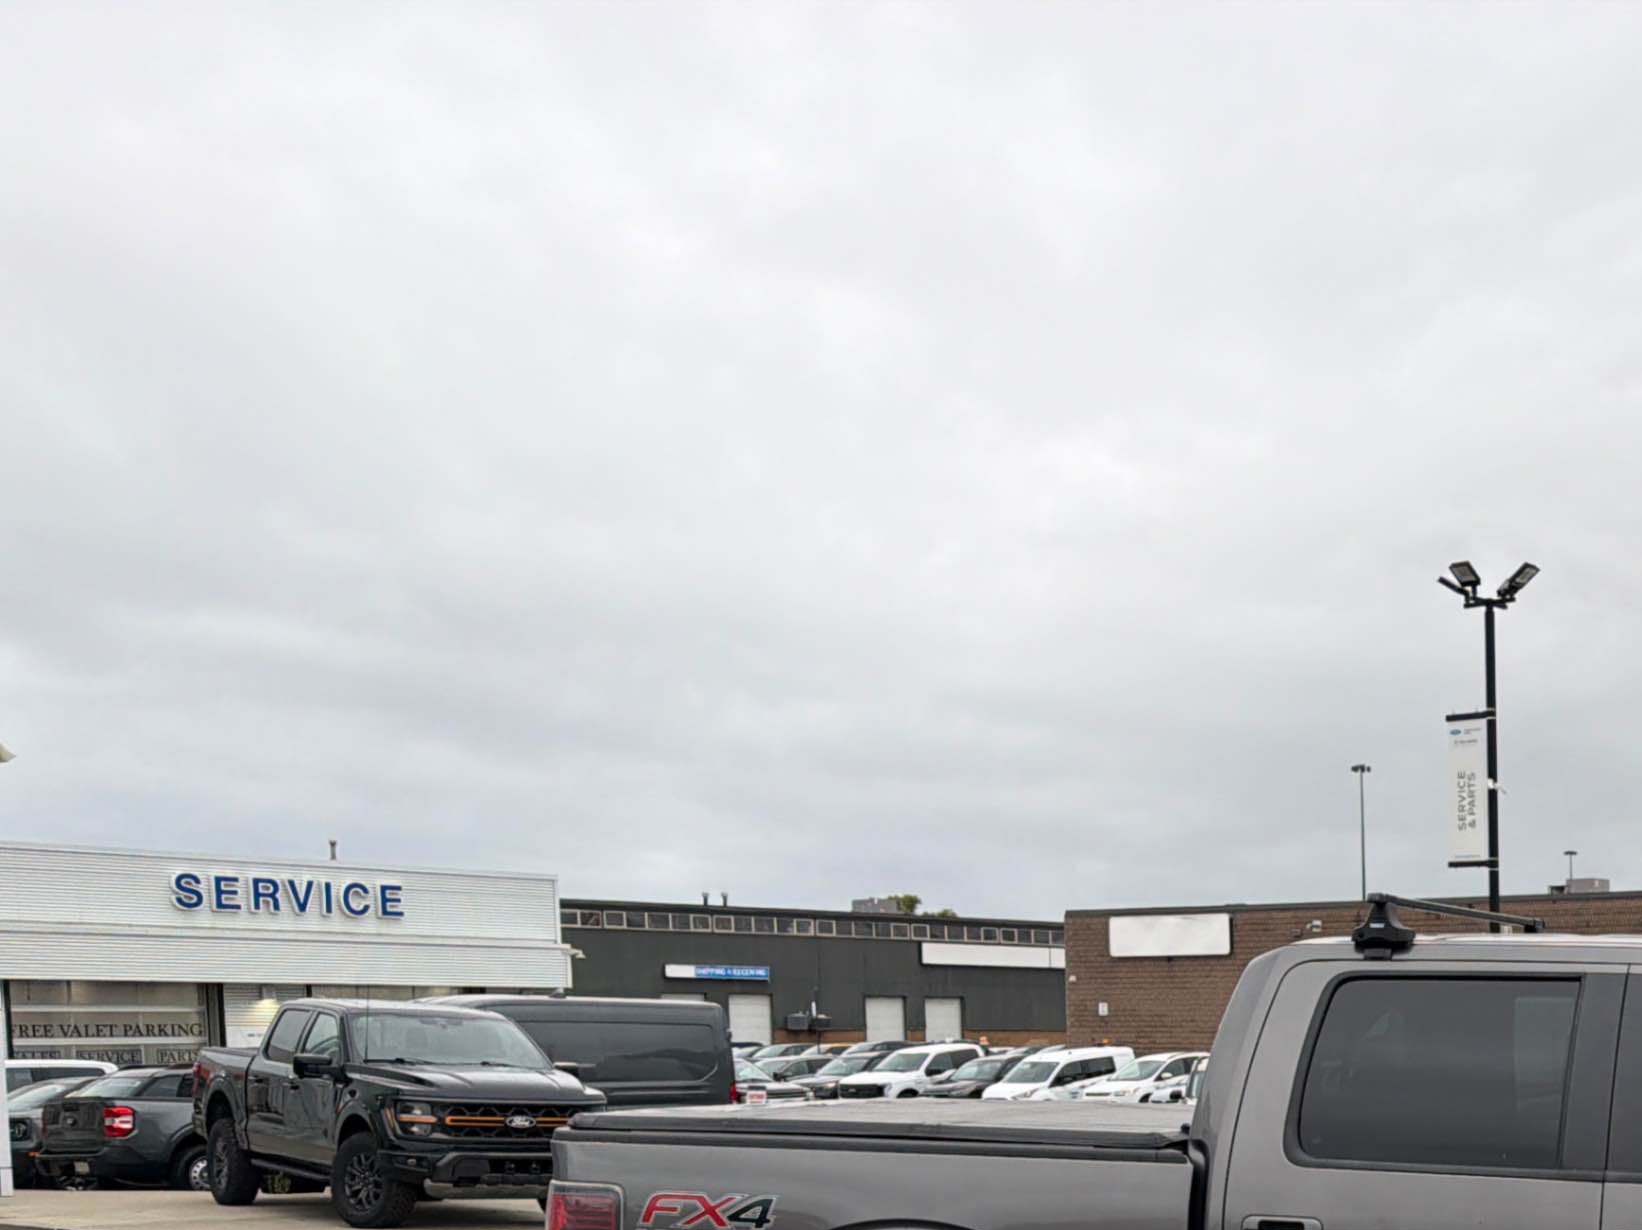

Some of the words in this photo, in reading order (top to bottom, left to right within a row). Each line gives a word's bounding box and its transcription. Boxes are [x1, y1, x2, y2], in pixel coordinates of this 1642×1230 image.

[1456, 770, 1467, 831] SERVICE
[172, 871, 406, 920] SERVICE
[57, 1023, 119, 1038] VALET
[122, 1023, 203, 1038] PARKING
